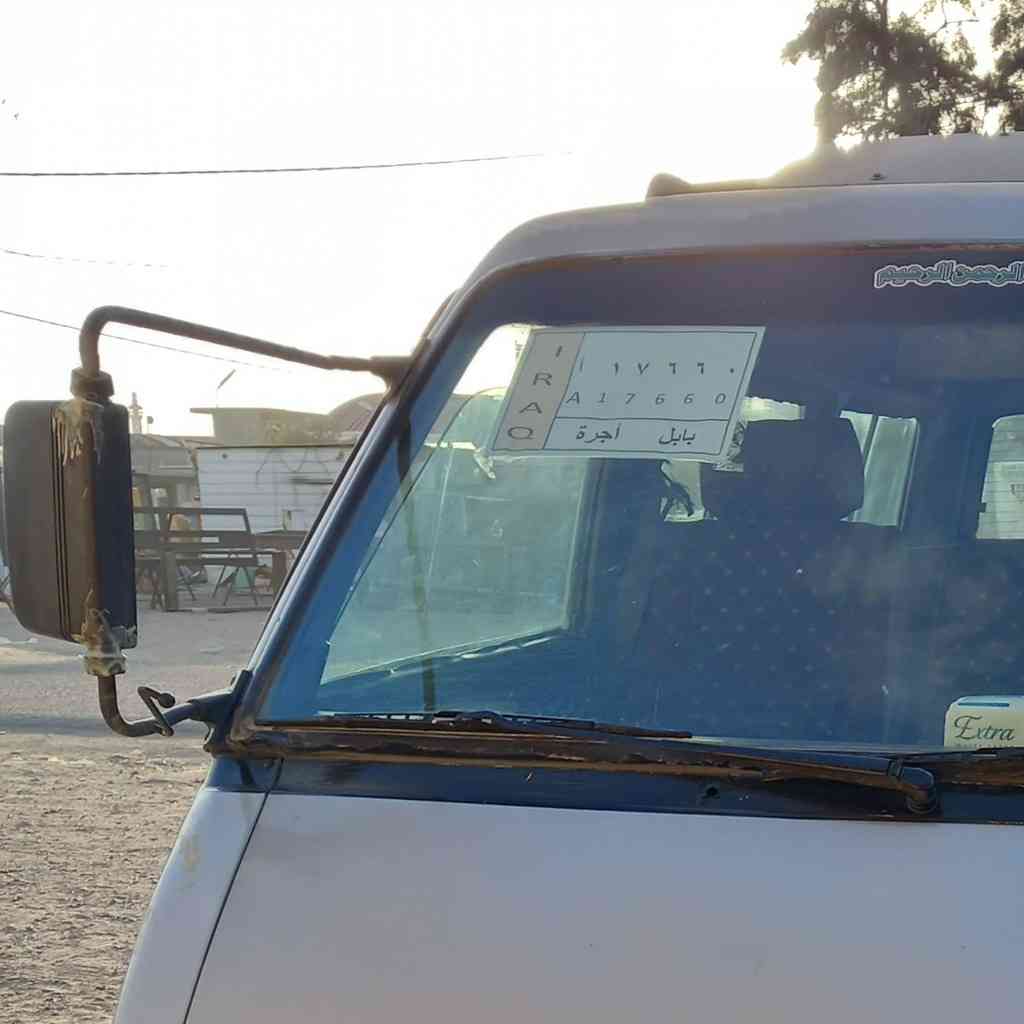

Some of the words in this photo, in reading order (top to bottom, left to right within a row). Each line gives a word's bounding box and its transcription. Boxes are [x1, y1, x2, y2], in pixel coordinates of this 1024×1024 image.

[874, 260, 956, 288] الرحيم
[658, 427, 696, 445] بابل
[954, 715, 1016, 740] Extra
